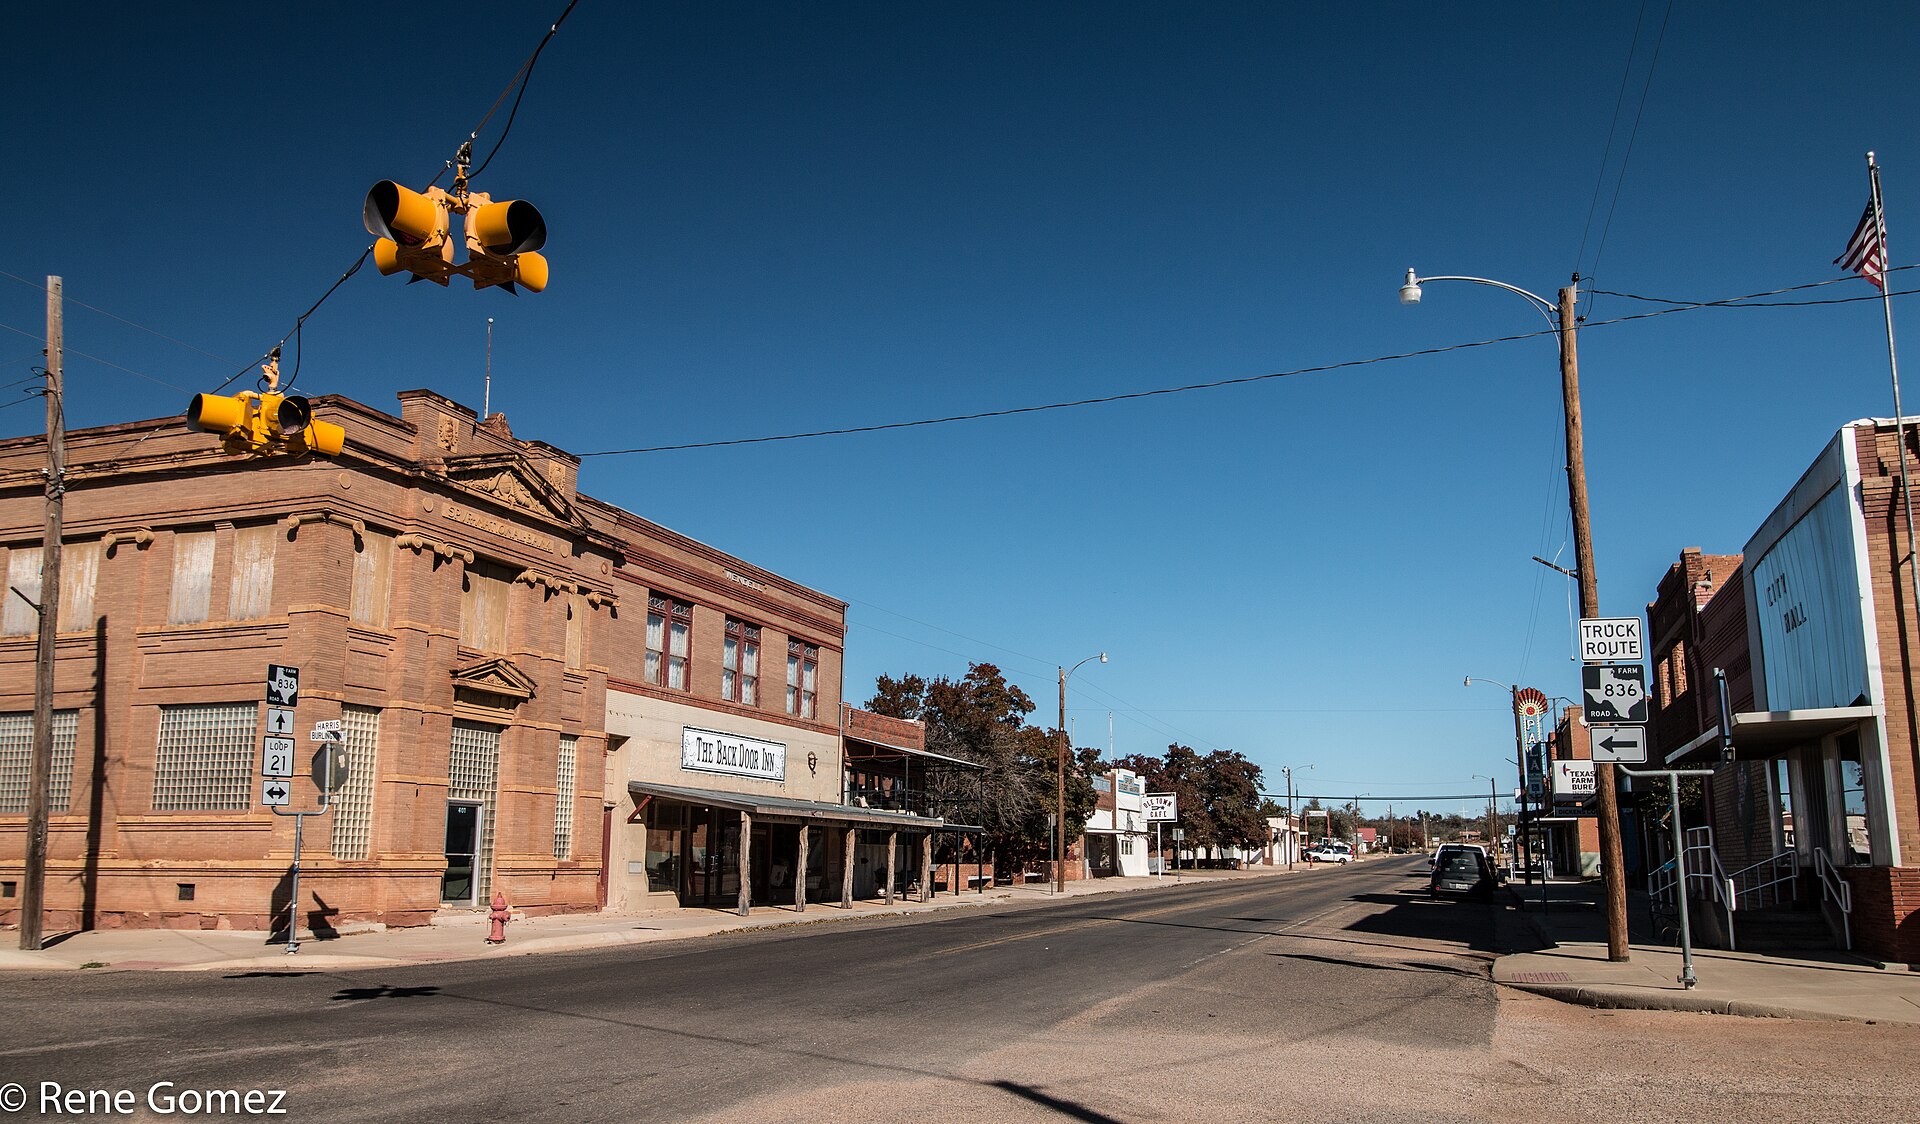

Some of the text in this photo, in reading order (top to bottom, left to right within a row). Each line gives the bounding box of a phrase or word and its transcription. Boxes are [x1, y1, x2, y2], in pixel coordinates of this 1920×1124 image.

[1767, 573, 1787, 607] CITY
[1784, 602, 1807, 634] HALL
[1583, 624, 1636, 638] TRUCK
[1586, 641, 1638, 655] ROUTE
[277, 679, 295, 690] 836
[1604, 683, 1637, 697] 836
[317, 721, 340, 730] HARRIS
[269, 742, 289, 751] LOOP
[696, 737, 775, 772] THE BACK DOOR INN
[270, 755, 286, 772] 21
[1156, 798, 1172, 807] TOWN
